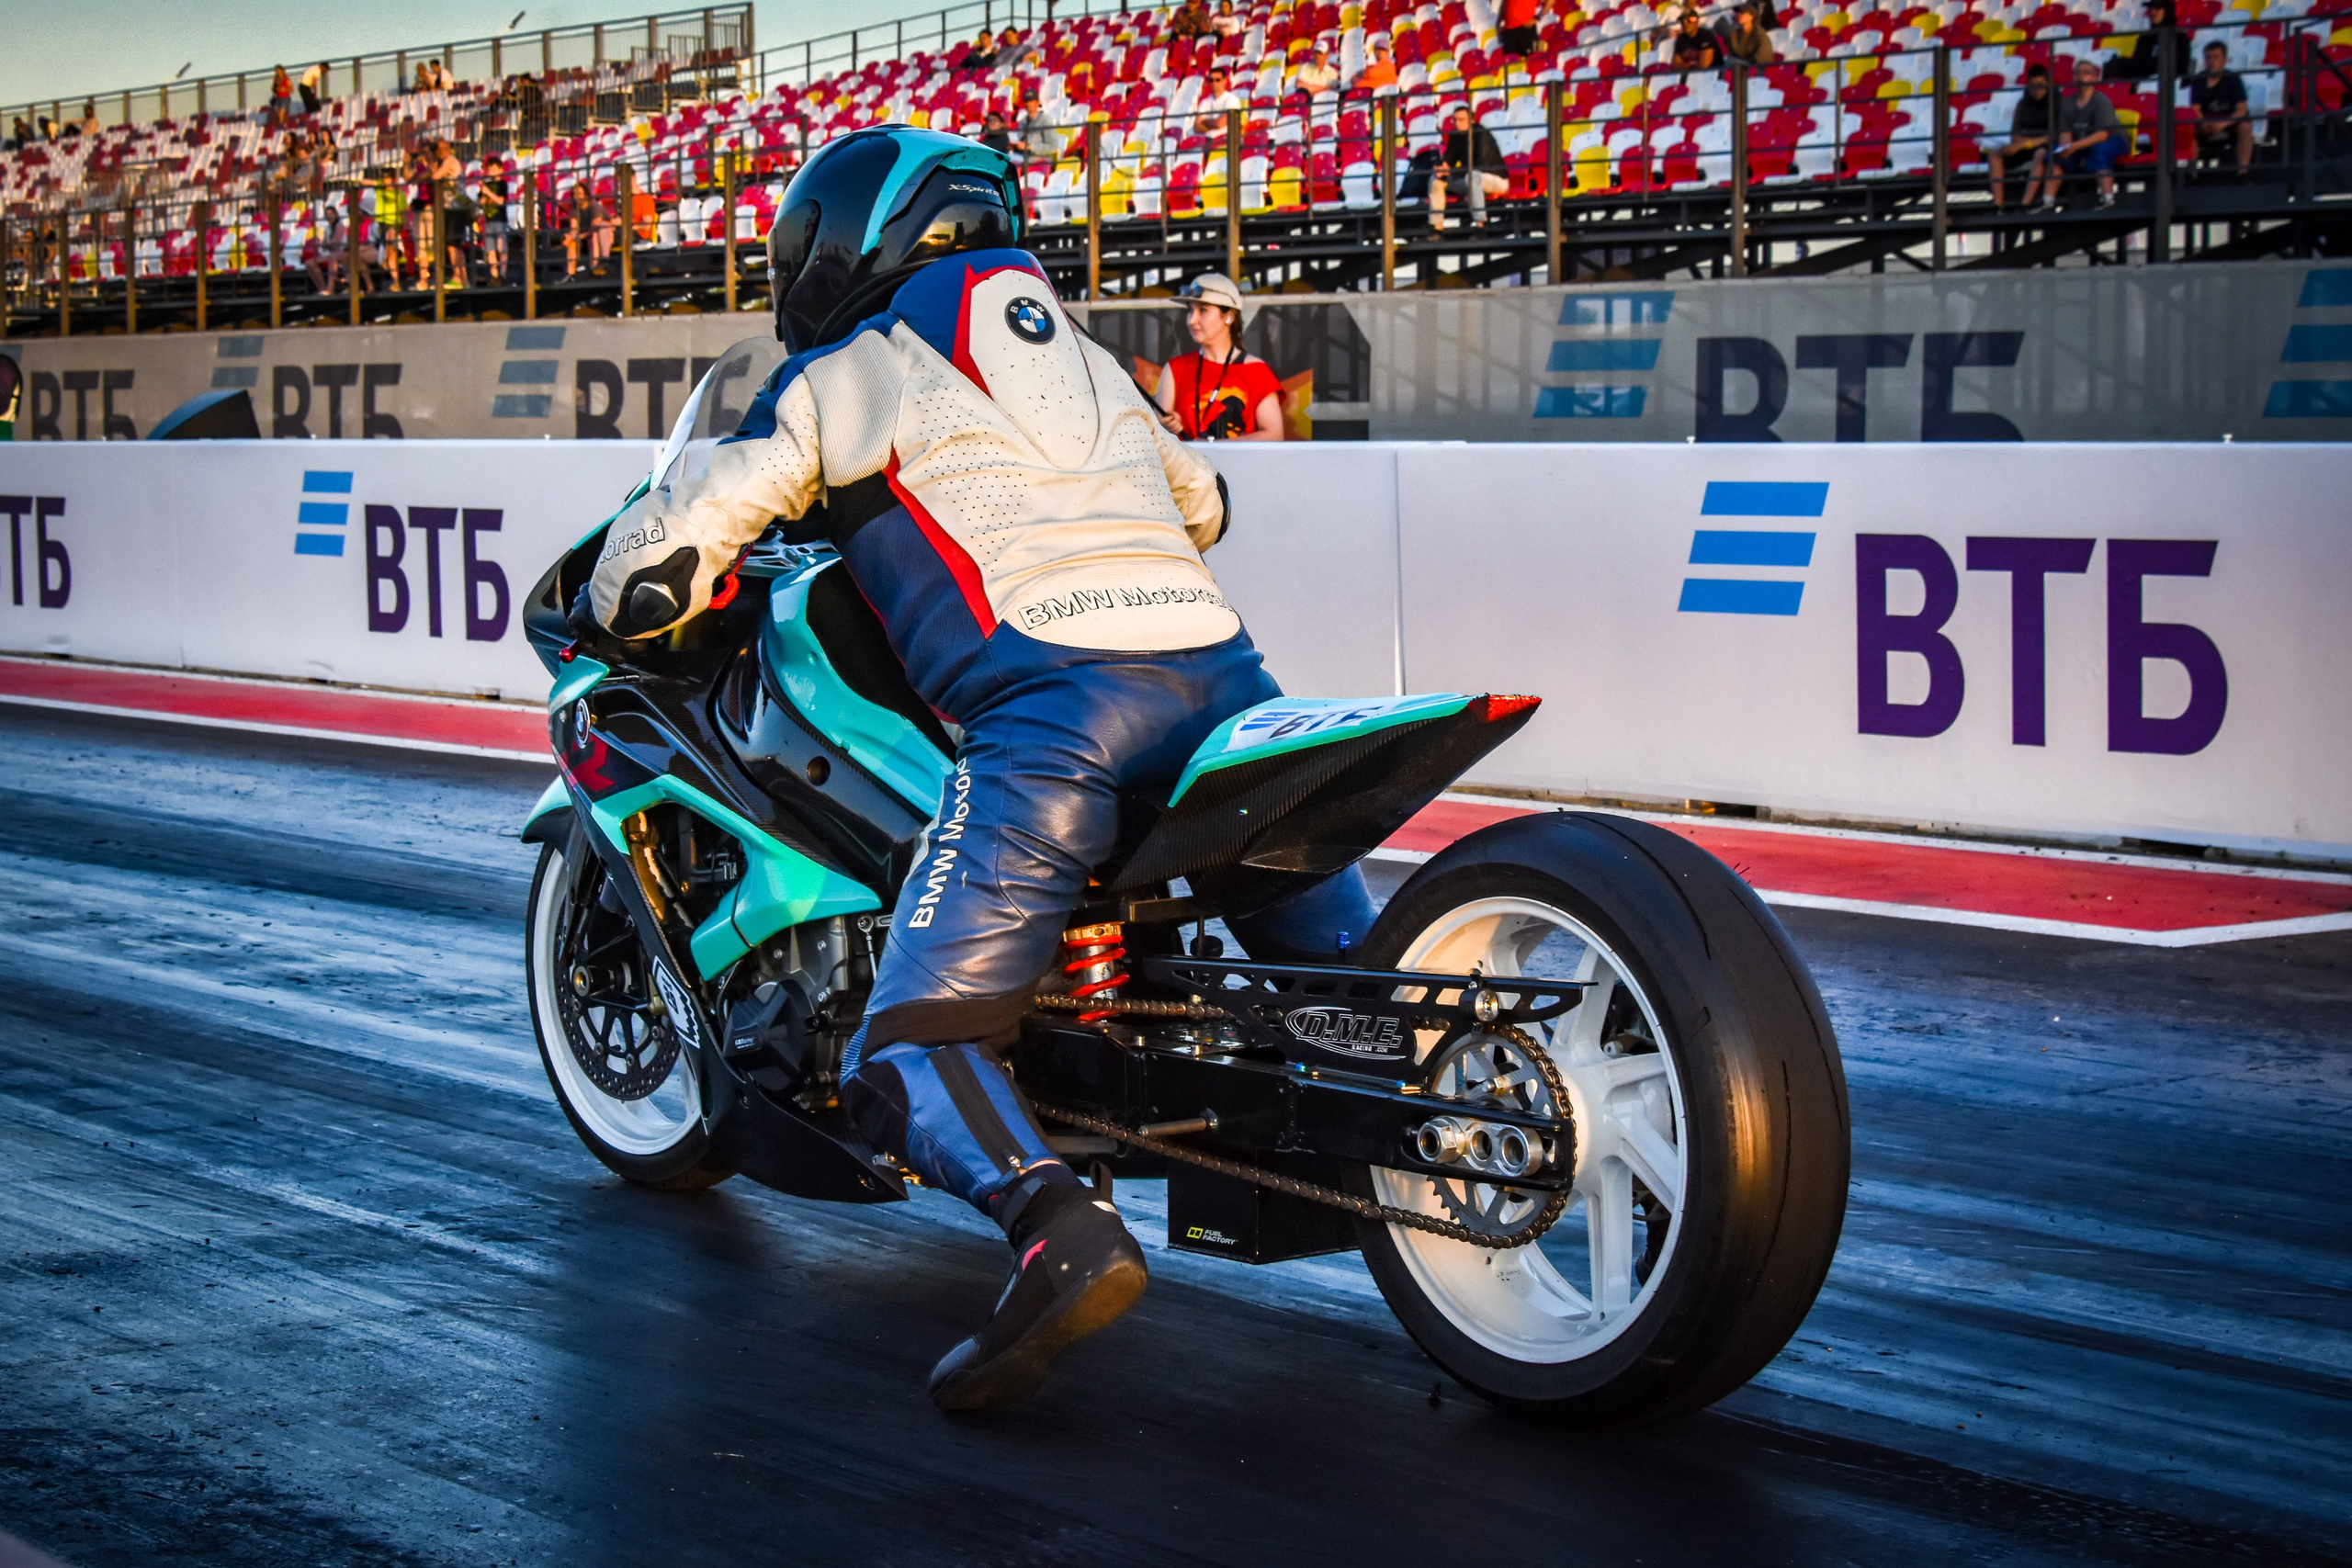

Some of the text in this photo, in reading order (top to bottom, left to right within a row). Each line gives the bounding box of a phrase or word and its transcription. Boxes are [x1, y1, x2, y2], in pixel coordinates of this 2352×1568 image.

[1010, 299, 1046, 313] BMW
[31, 369, 137, 441] ВТБ
[273, 364, 403, 439] ВТБ
[1695, 332, 2025, 443] ВТБ
[365, 504, 511, 642] ВТБ
[1018, 589, 1114, 630] BMW
[1855, 533, 2229, 756] ВТБ
[908, 849, 958, 929] BMW
[1204, 1229, 1223, 1237] FUEL
